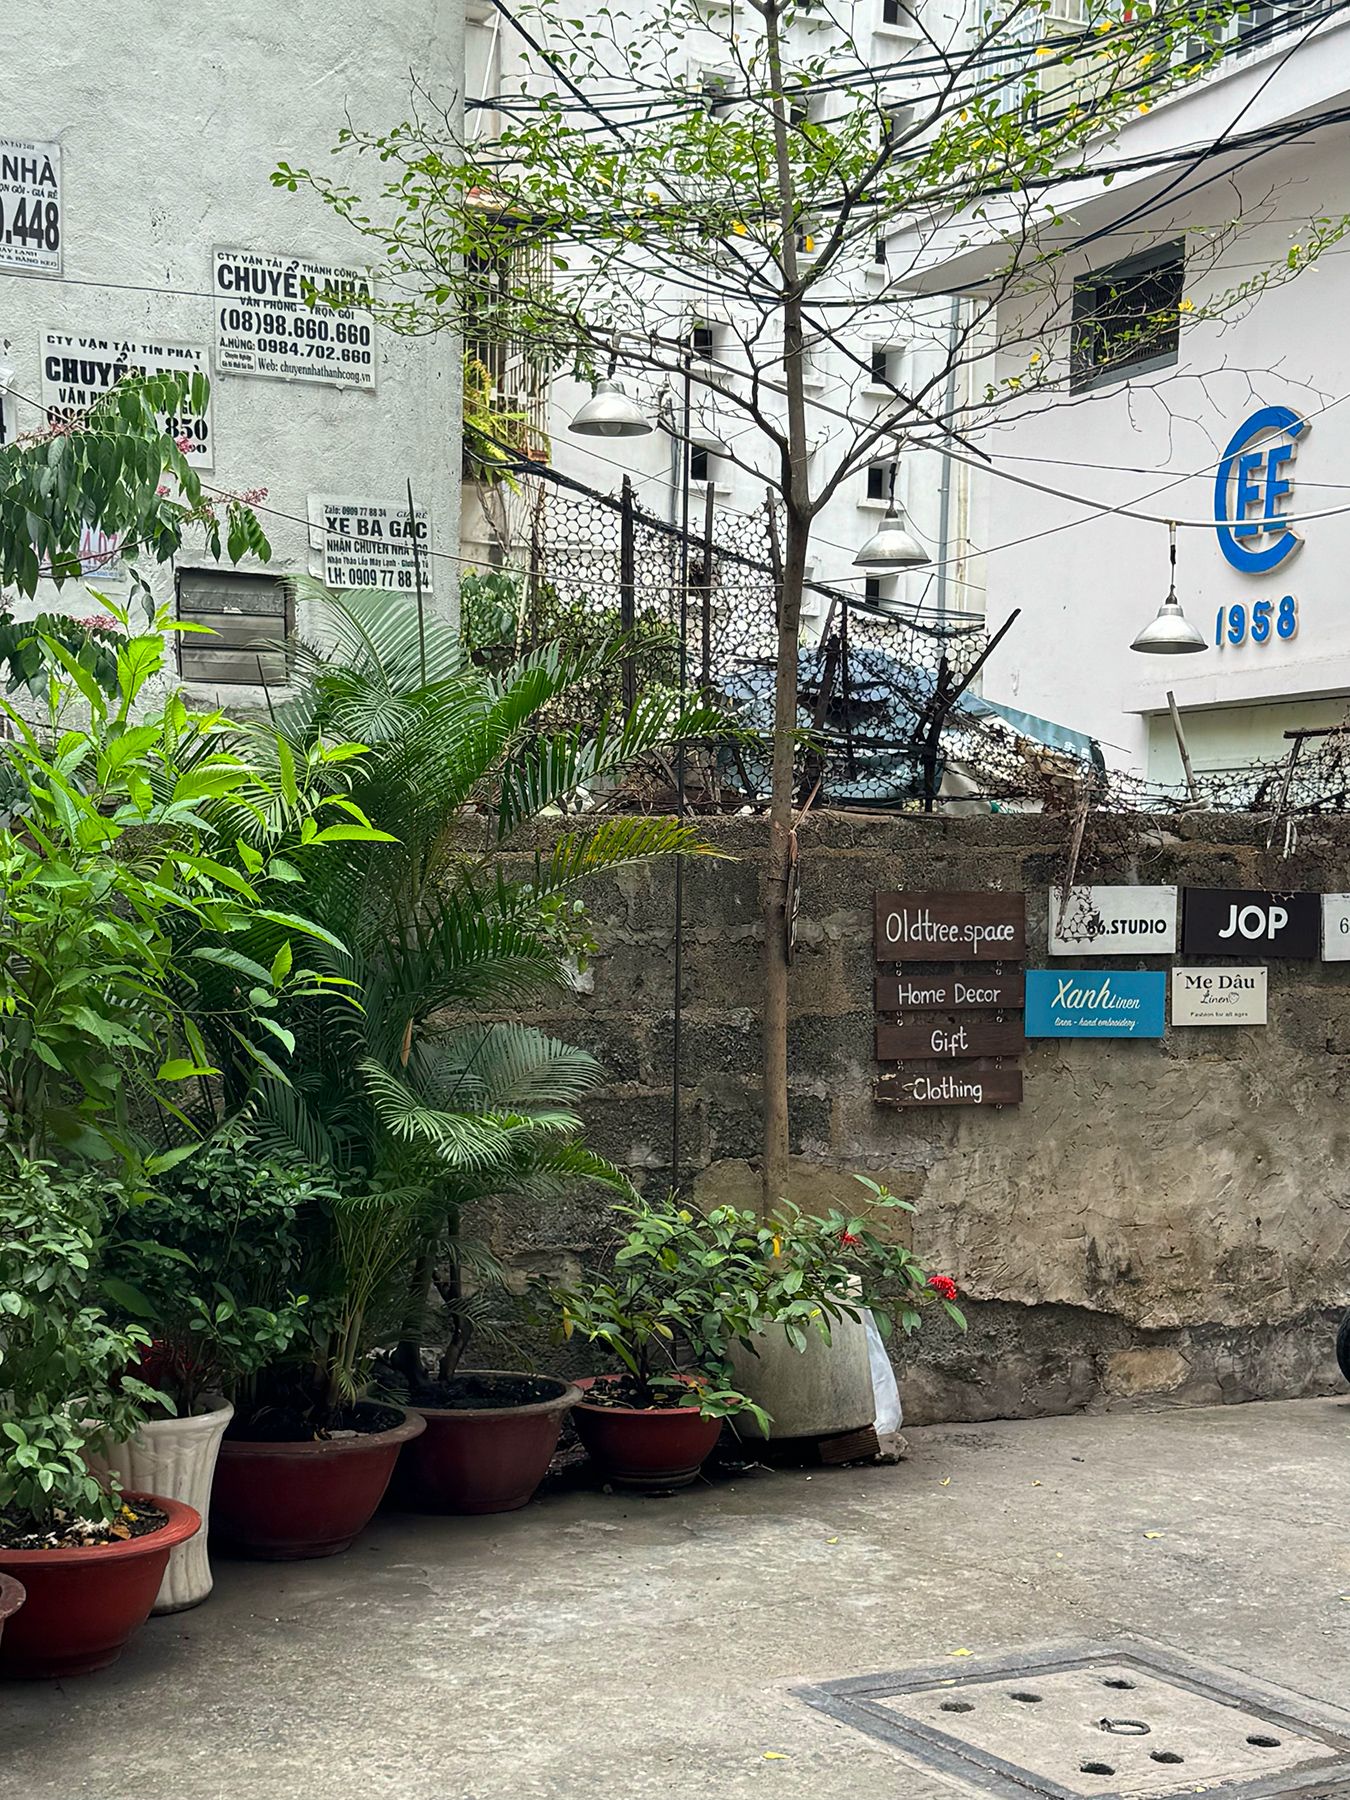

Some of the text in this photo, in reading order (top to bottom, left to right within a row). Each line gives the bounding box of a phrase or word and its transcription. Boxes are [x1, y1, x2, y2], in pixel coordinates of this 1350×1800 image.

[2, 153, 58, 188] NHÀ
[217, 252, 358, 279] CTY VẬN TẢI THÀNH CÔNG
[217, 260, 316, 299] CHUYỂN
[239, 296, 260, 308] VĂN
[263, 298, 297, 313] PHÒNG
[220, 307, 371, 346] (08)98.660.660
[47, 335, 73, 346] CTY
[79, 337, 108, 351] VẬN
[113, 341, 136, 353] TẢI
[141, 344, 163, 356] TÍN
[219, 335, 371, 364] A.HÙNG: 0984.702.660
[257, 357, 279, 372] Web:
[280, 360, 371, 384] chuyennhathanhcong.vn
[59, 386, 86, 405] VĂN
[325, 504, 341, 515] Zalo:
[326, 517, 351, 535] XE
[389, 518, 428, 539] GÁC
[327, 537, 352, 555] NHẬN
[328, 567, 346, 585] LH:
[348, 568, 377, 586] 0909
[380, 570, 395, 588] 77
[397, 571, 412, 588] 88
[1215, 595, 1298, 646] 1958
[886, 908, 1014, 954] Oldtree.space
[1218, 905, 1289, 940] JOP
[898, 982, 1001, 1005] Home Decor
[1218, 974, 1255, 989] Dâu
[1200, 990, 1230, 1004] Linen
[1098, 1016, 1137, 1031] embroidery
[931, 1026, 969, 1057] Gift
[913, 1076, 983, 1104] Clothing
